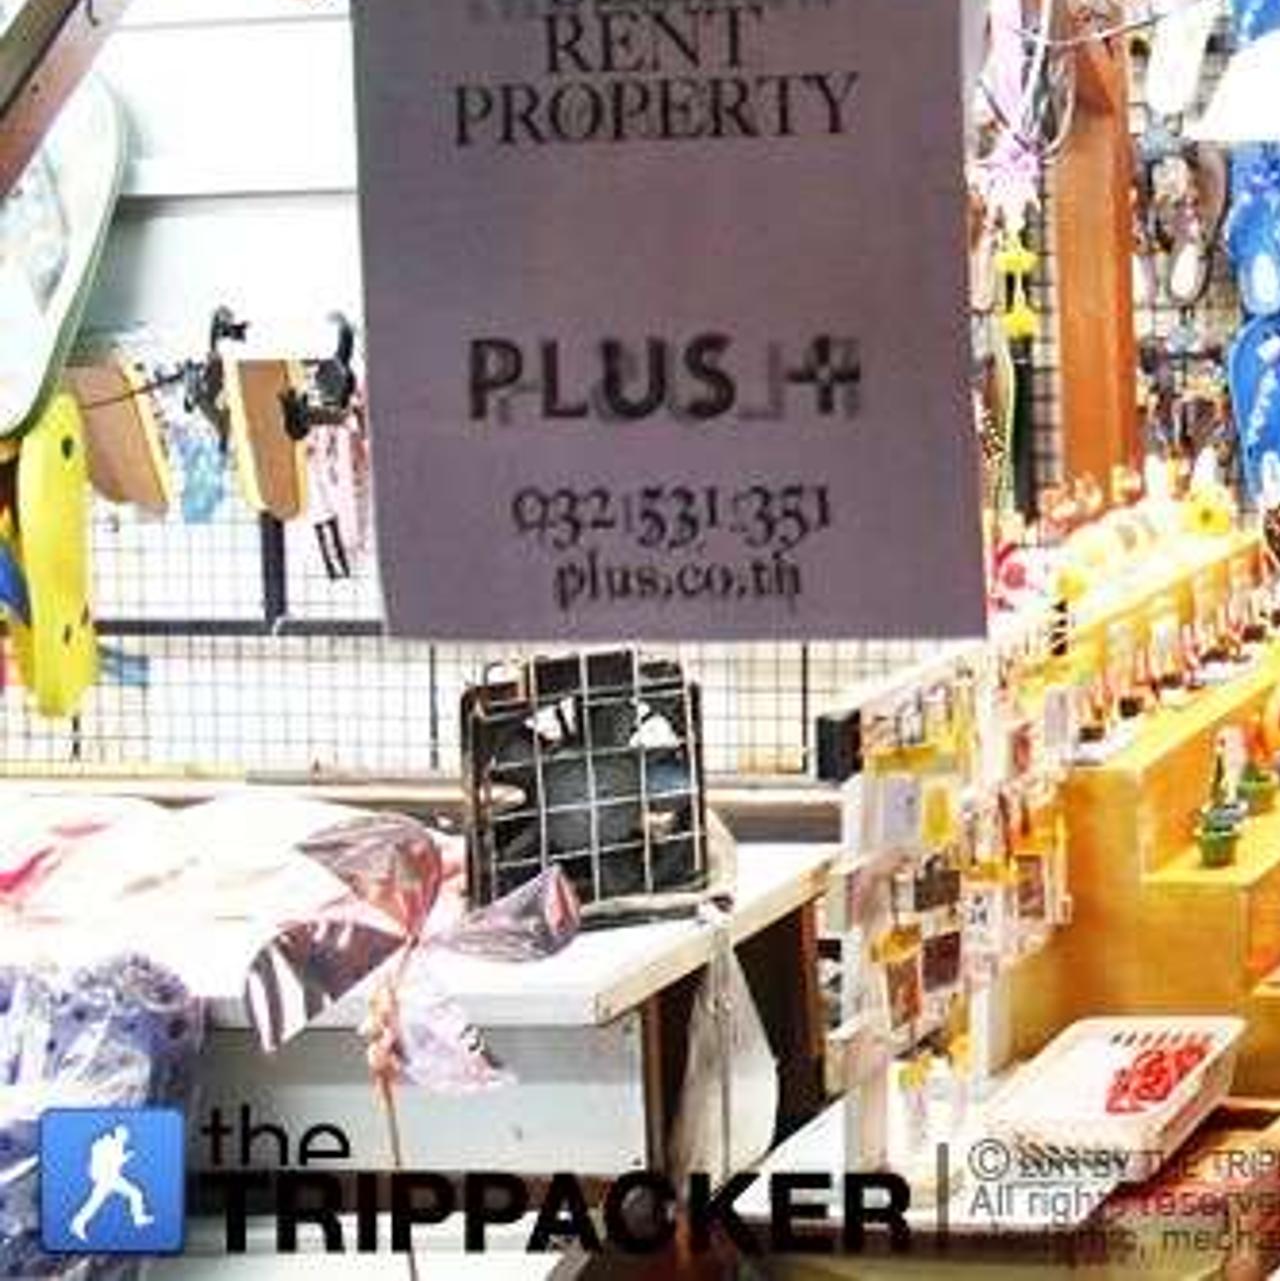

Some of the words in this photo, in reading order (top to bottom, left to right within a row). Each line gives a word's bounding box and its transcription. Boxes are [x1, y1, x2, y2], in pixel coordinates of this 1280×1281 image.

[545, 5, 766, 73] RENT
[453, 72, 859, 148] PROPERTY
[469, 334, 737, 420] PLUS
[553, 551, 803, 612] plus.co.th
